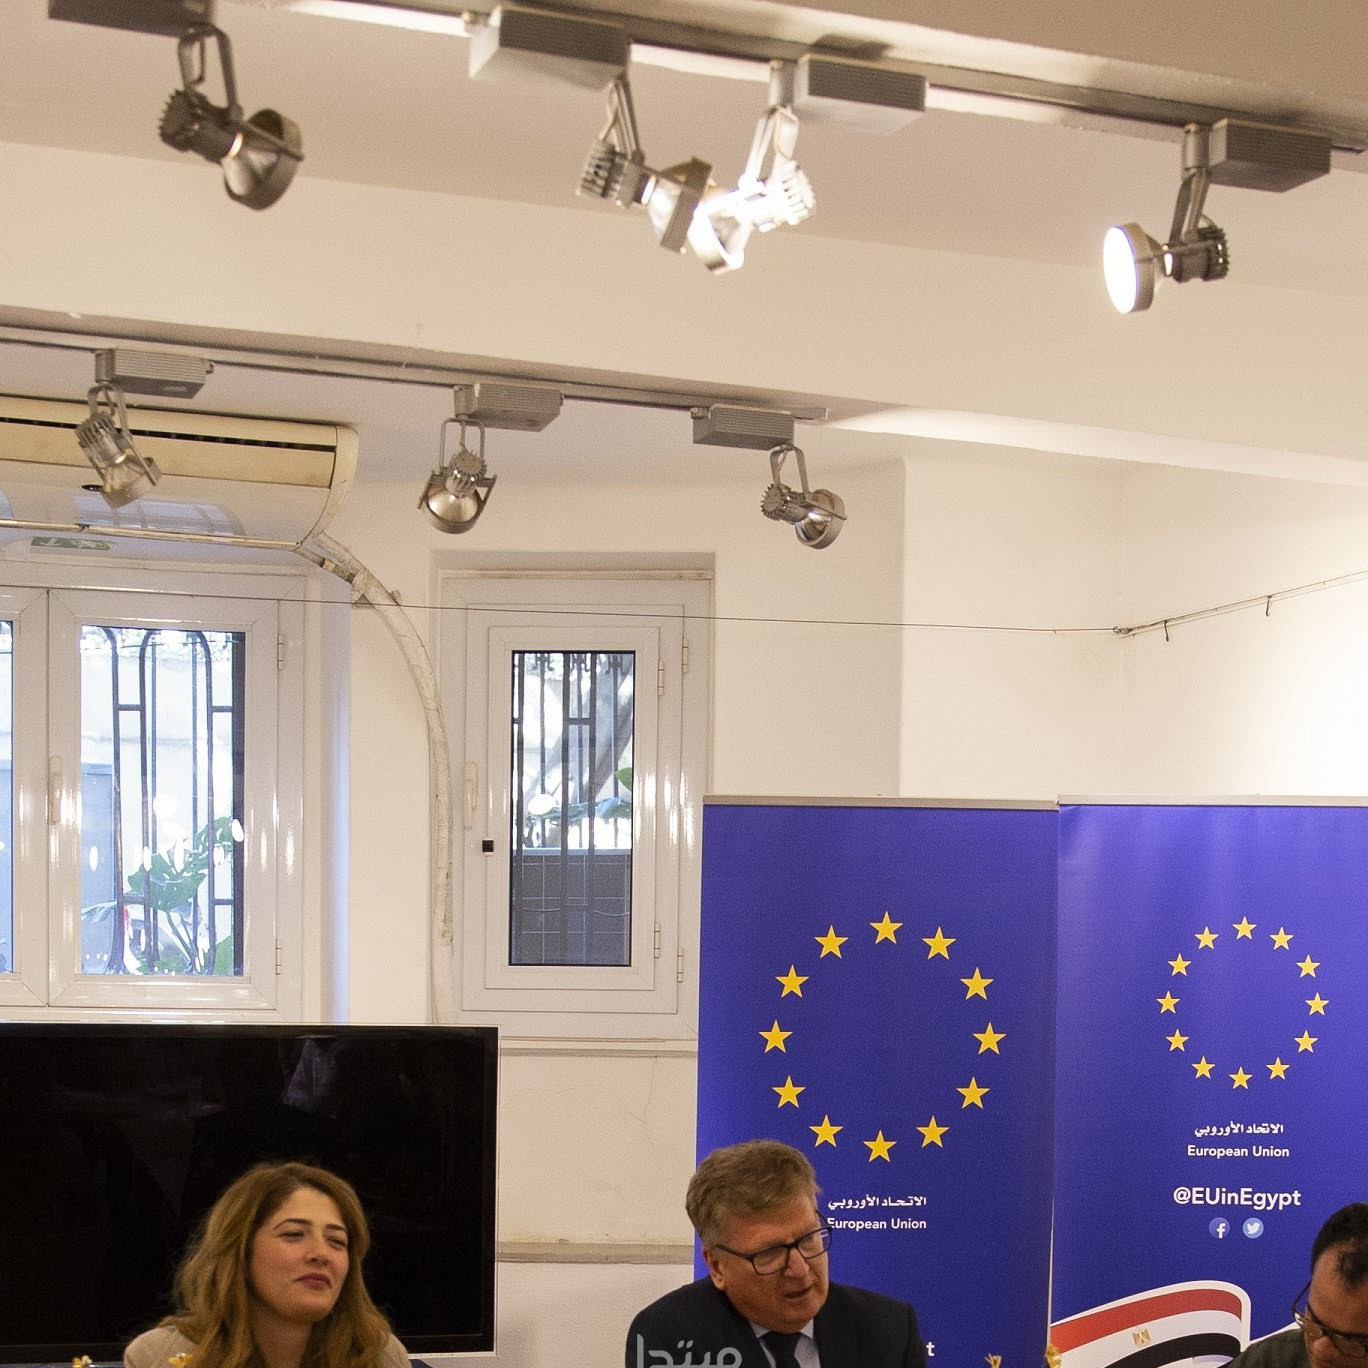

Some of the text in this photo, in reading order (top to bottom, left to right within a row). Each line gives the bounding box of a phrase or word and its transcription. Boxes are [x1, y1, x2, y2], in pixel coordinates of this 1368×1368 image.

[1194, 1120, 1284, 1138] الاتحاد الأوروبي
[1187, 1145, 1290, 1159] European Union
[828, 1194, 927, 1210] الاتحاد الأوروبي
[1173, 1186, 1302, 1210] @EUinEgypt
[827, 1218, 927, 1231] European Union
